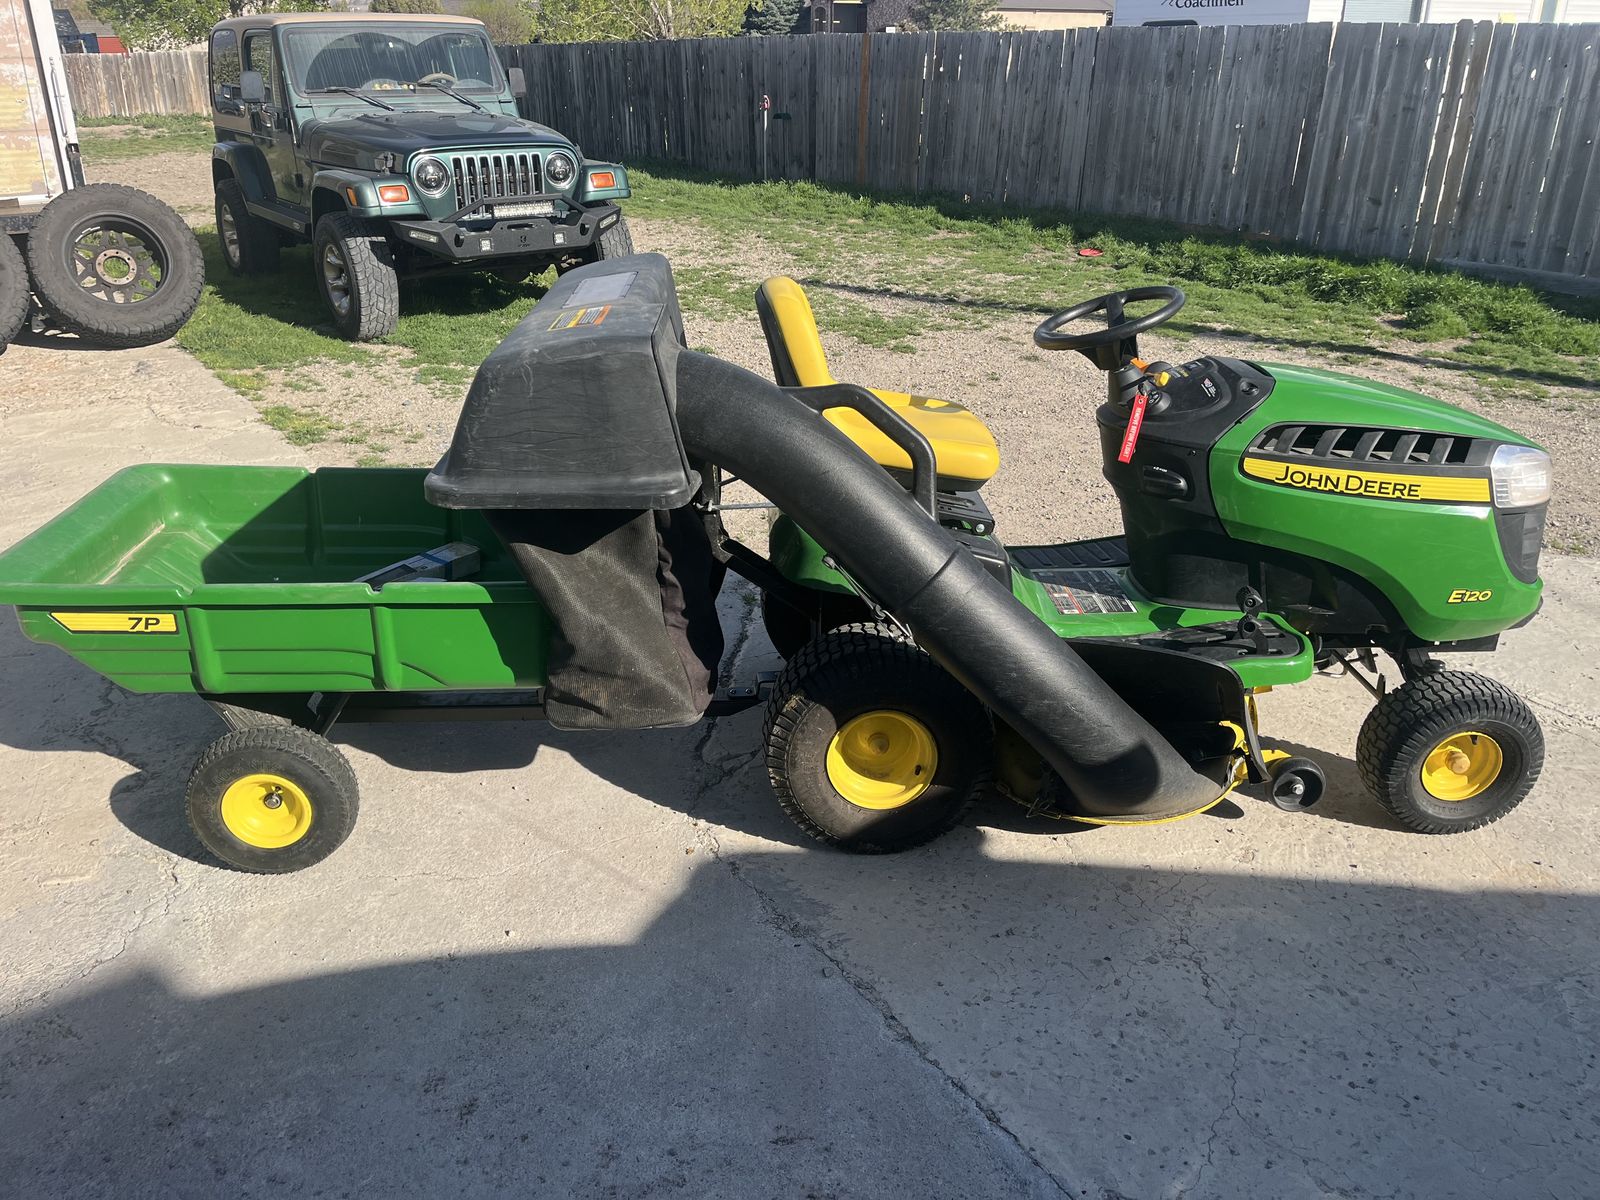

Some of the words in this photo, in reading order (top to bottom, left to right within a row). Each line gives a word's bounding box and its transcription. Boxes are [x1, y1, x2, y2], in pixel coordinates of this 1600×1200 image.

[1275, 466, 1340, 490] JOHN
[1345, 475, 1422, 497] DEERE
[1447, 589, 1492, 603] E120
[128, 617, 160, 630] 7P
